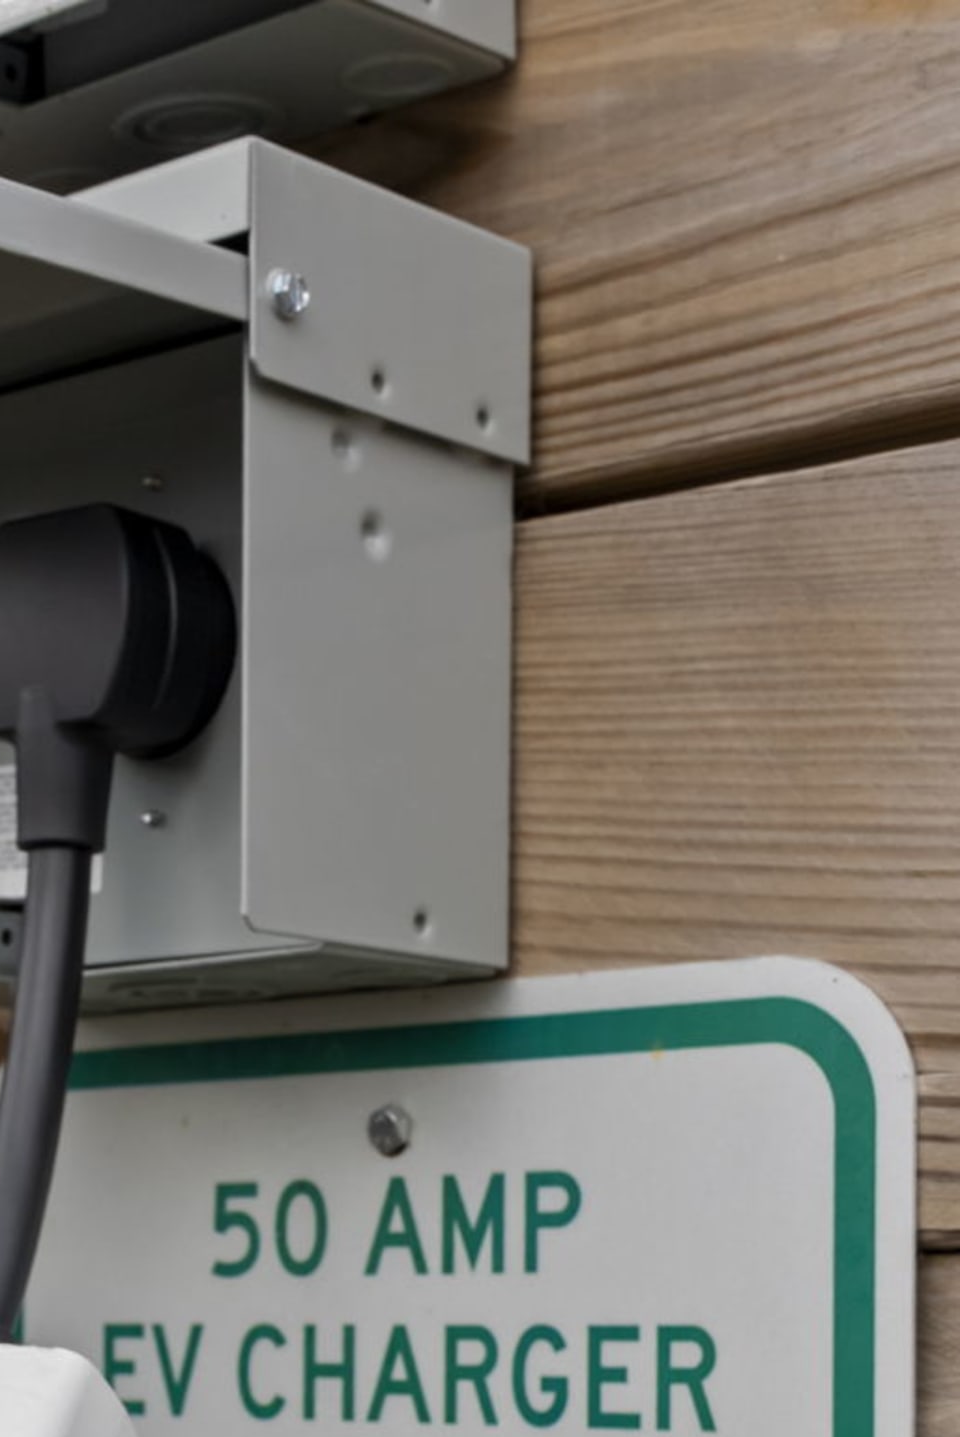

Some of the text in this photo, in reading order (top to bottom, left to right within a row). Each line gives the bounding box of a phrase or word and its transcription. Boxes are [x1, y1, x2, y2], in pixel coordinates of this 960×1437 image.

[212, 1170, 583, 1278] 50 AMP
[102, 1323, 718, 1433] EV CHARGER
